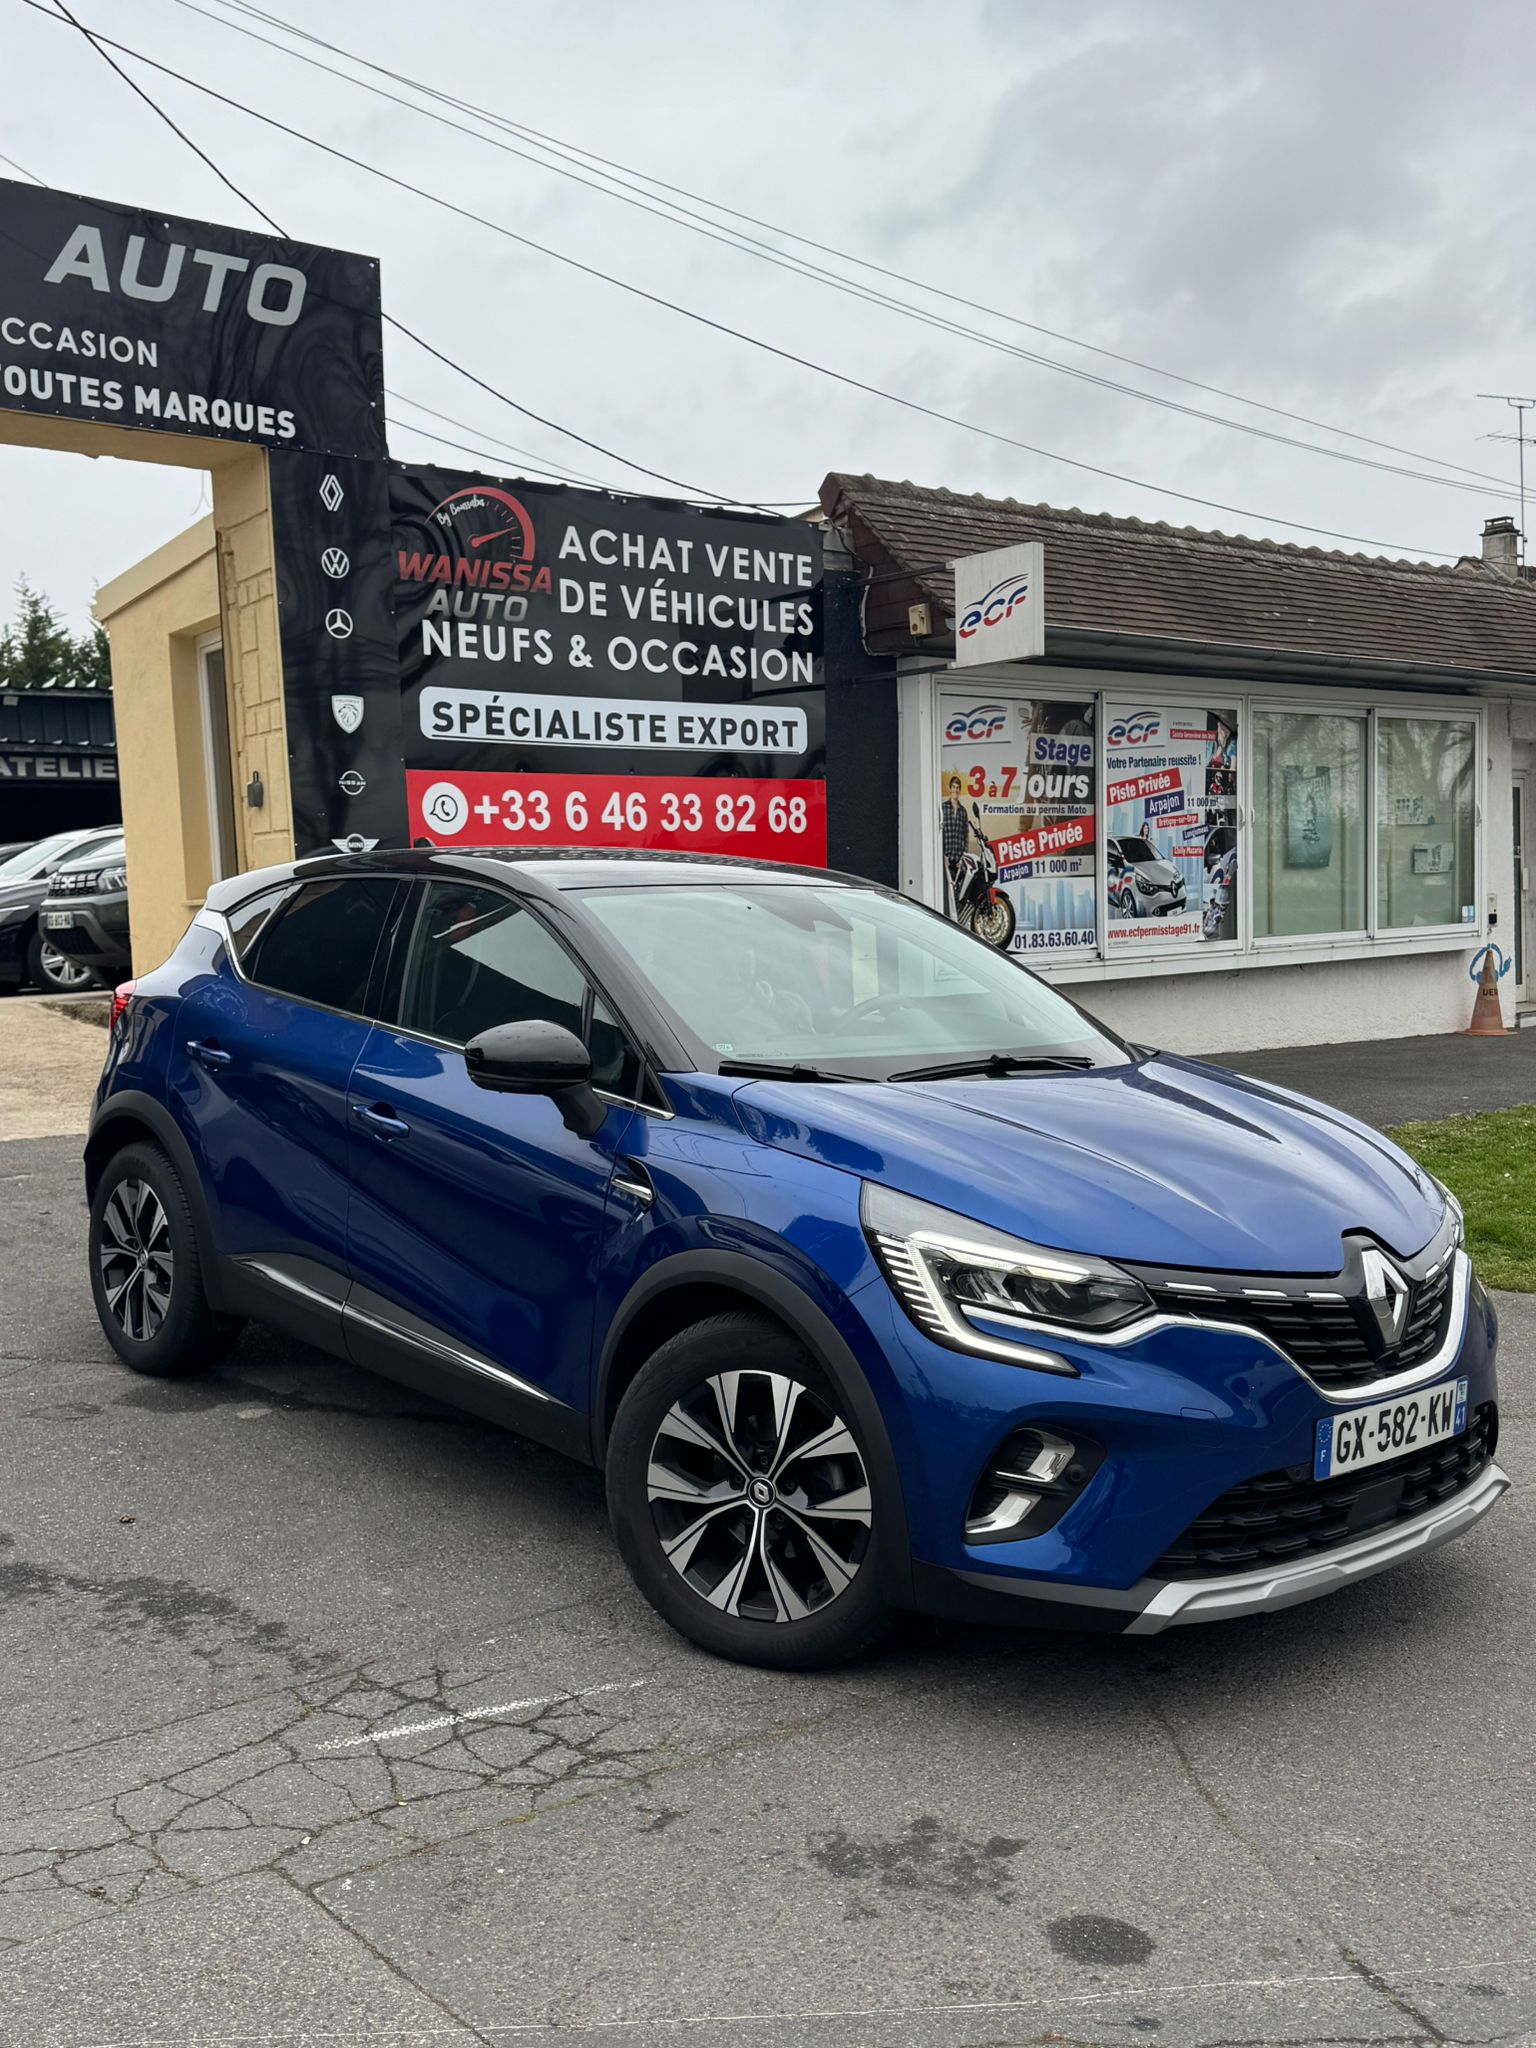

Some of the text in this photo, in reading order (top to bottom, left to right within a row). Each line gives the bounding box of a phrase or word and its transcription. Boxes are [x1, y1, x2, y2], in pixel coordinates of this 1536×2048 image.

[43, 223, 308, 327] AUTO
[0, 364, 297, 439] OUTES MARQUES
[399, 550, 552, 595] WANISSA
[558, 525, 813, 588] ACHAT VENTE
[425, 588, 528, 622] AUTO
[558, 578, 814, 636] DE VÉHICULES
[421, 619, 814, 684] NEUFS & OCCASION
[432, 696, 799, 748] SPÉCIALISTE EXPORT
[1034, 736, 1092, 767] Stage
[1107, 756, 1127, 769] Votre
[1129, 755, 1167, 769] Partenaire
[967, 765, 1090, 805] 3 à 7 jours
[1109, 773, 1171, 803] Piste Privée
[1187, 798, 1195, 807] 11
[1197, 797, 1209, 808] 000
[474, 788, 808, 834] +33 6 46 33 82 68
[983, 804, 1087, 816] Formation au permis Moto
[1149, 795, 1180, 815] Arpajon
[998, 822, 1083, 864] Piste Privée
[1003, 864, 1029, 881] Arpajon
[1034, 860, 1046, 874] 11
[1050, 859, 1067, 873] 000
[1014, 930, 1094, 949] 01.83.63.60.40
[1107, 923, 1201, 939] www.ecfpermisstage91.fr
[1320, 1449, 1327, 1463] F
[1336, 1389, 1454, 1465] GX-582-KW
[1455, 1406, 1466, 1426] 41
